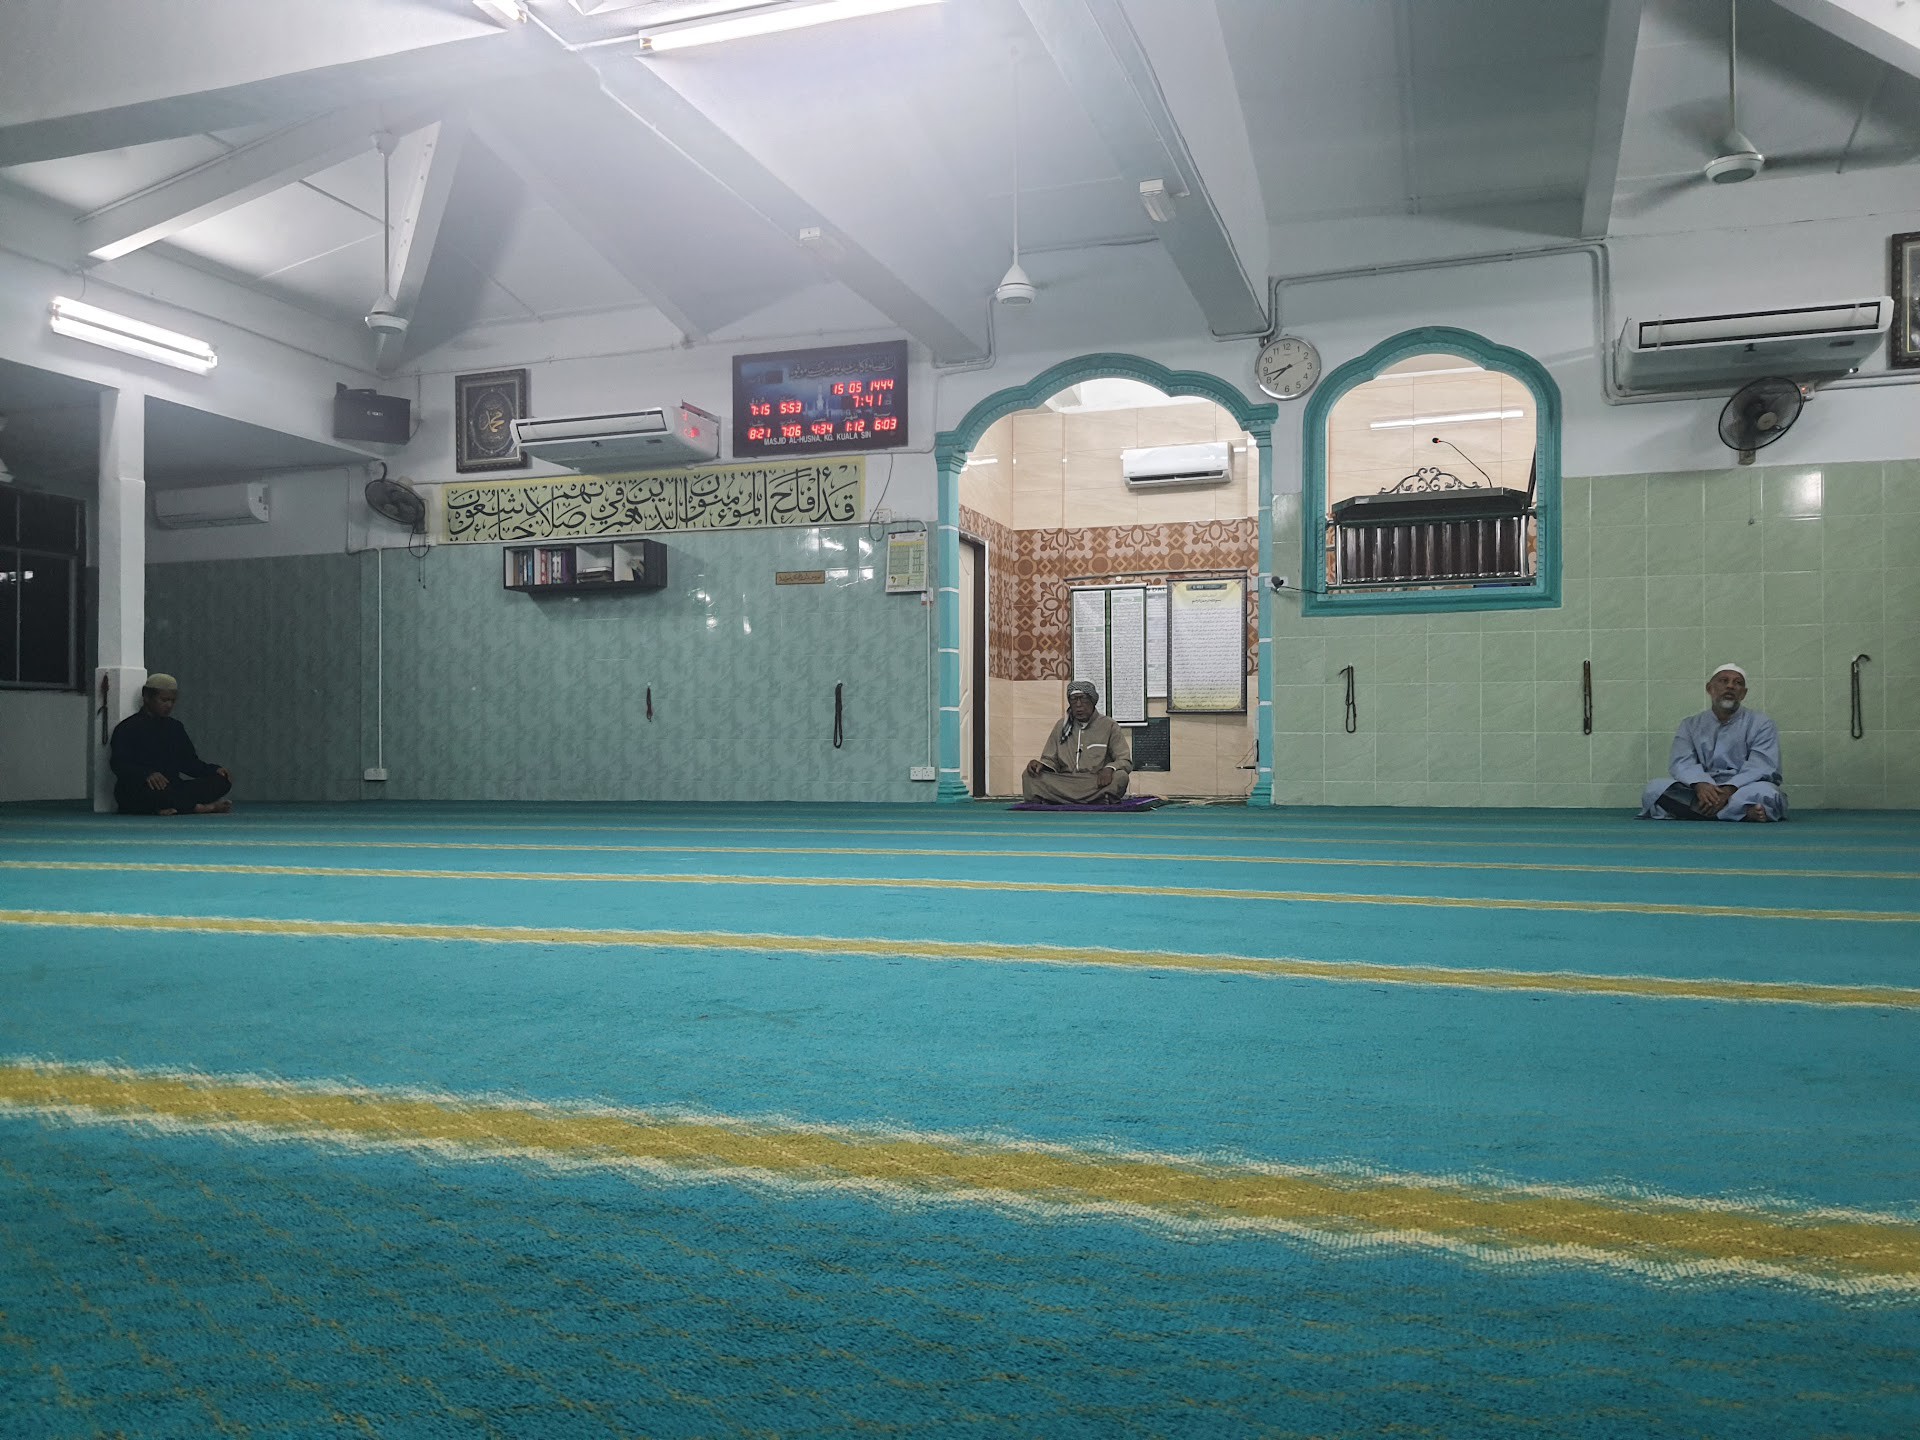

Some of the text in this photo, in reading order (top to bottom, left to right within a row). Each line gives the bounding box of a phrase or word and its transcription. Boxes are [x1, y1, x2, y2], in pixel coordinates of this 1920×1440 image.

[1273, 347, 1279, 355] 11
[1283, 342, 1291, 351] 12
[1265, 356, 1273, 364] 10
[1303, 352, 1309, 360] 2
[1263, 366, 1269, 375] 9
[1307, 362, 1312, 370] 3
[1266, 376, 1272, 384] 8
[1296, 381, 1301, 389] 5
[833, 379, 894, 395] 15 05 1444
[1274, 382, 1279, 391] 7
[1285, 385, 1290, 393] 6
[852, 393, 882, 408] 7:41
[750, 403, 771, 416] 7:15
[780, 401, 802, 415] 5:53
[811, 422, 833, 435] 4:34
[846, 420, 865, 432] 1:12
[874, 417, 897, 431] 6:03
[749, 427, 771, 440] 8:21
[781, 424, 802, 437] 7:06
[764, 437, 787, 445] MASJID
[836, 432, 858, 440] KUALA
[861, 430, 872, 439] SIN
